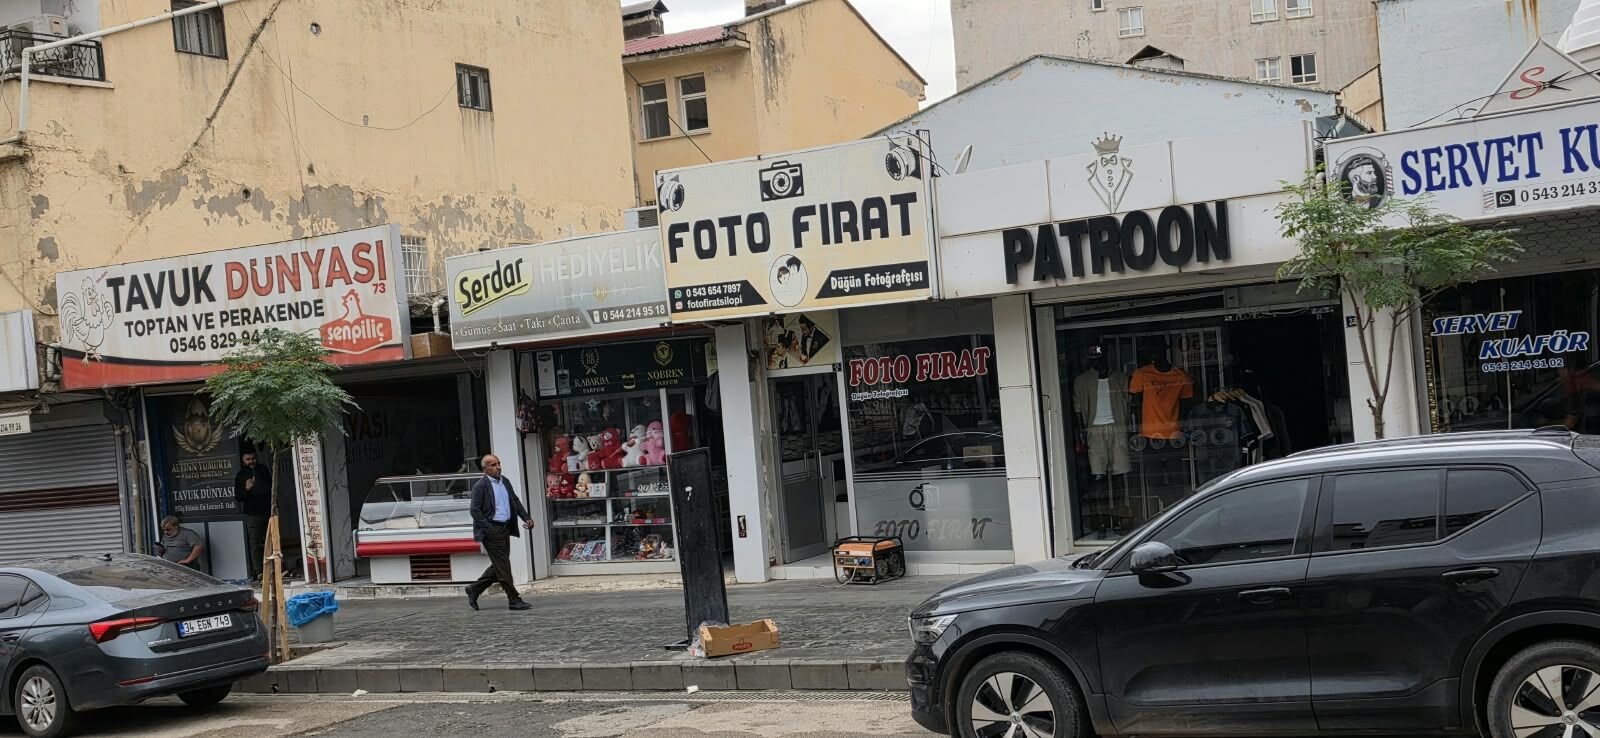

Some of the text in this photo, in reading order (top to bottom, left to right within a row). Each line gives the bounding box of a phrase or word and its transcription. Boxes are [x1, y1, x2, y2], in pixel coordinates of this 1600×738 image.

[1400, 131, 1544, 196] SERVET
[1521, 190, 1529, 202] 0
[1532, 187, 1558, 201] 543
[1561, 182, 1585, 197] 214
[668, 191, 917, 263] FOTO FIRAT
[1002, 200, 1231, 284] PATROON
[540, 241, 660, 284] HEDİYELİK
[106, 240, 387, 314] TAVUK DÜNYASI
[372, 283, 386, 294] 73
[459, 257, 523, 310] Serdar
[830, 268, 923, 292] Düğün Fotoğrafçısı
[686, 284, 741, 298] 0 543 654 7897
[124, 298, 325, 338] TOPTAN VE PERAKENDE
[602, 304, 665, 321] 0 544 214 95 18
[1431, 310, 1523, 336] SERVET
[327, 318, 385, 345] şenpiliç
[460, 315, 581, 337] Gümüş Saat Takı Çanta
[169, 334, 206, 354] 0546
[210, 331, 237, 350] 829
[1479, 330, 1590, 359] KUAFÖR
[849, 346, 990, 386] FOTO FIRAT
[1482, 358, 1564, 373] 0543 214 31 02
[172, 485, 236, 501] TAVUK DÜNYASI
[184, 622, 194, 633] 34
[215, 615, 230, 627] 749
